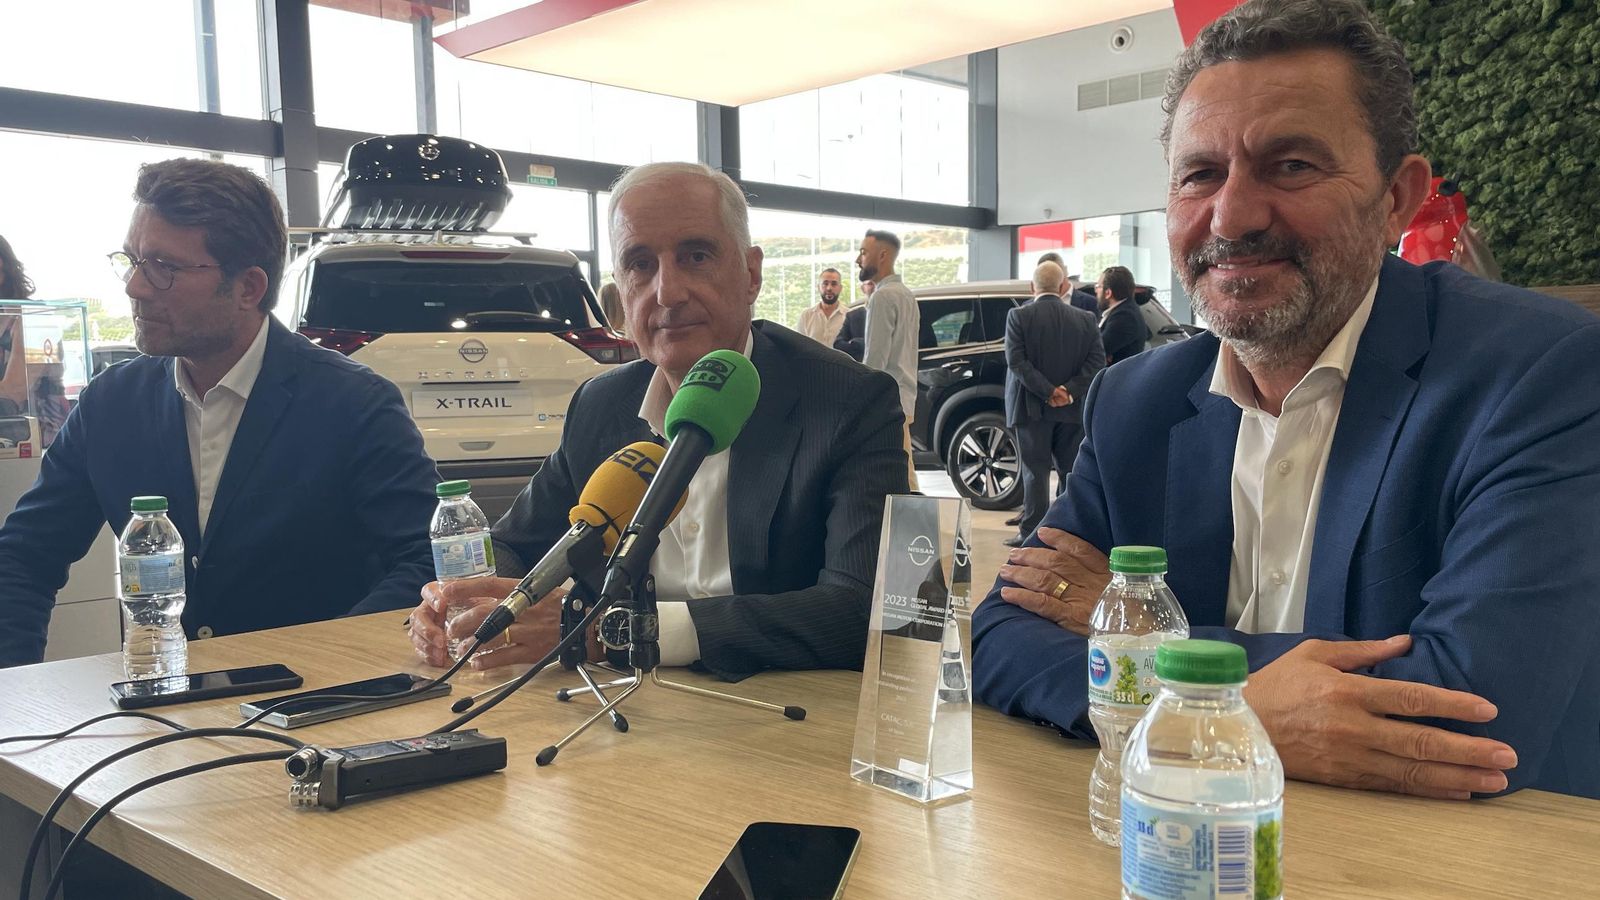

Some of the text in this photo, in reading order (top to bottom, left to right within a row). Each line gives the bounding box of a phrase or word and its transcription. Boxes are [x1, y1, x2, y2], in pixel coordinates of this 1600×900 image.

[418, 368, 528, 379] X-TRAIL
[436, 397, 512, 409] X-TRAIL
[908, 547, 935, 555] NISSAN
[884, 594, 907, 607] 2023
[913, 617, 943, 627] CORPORATION
